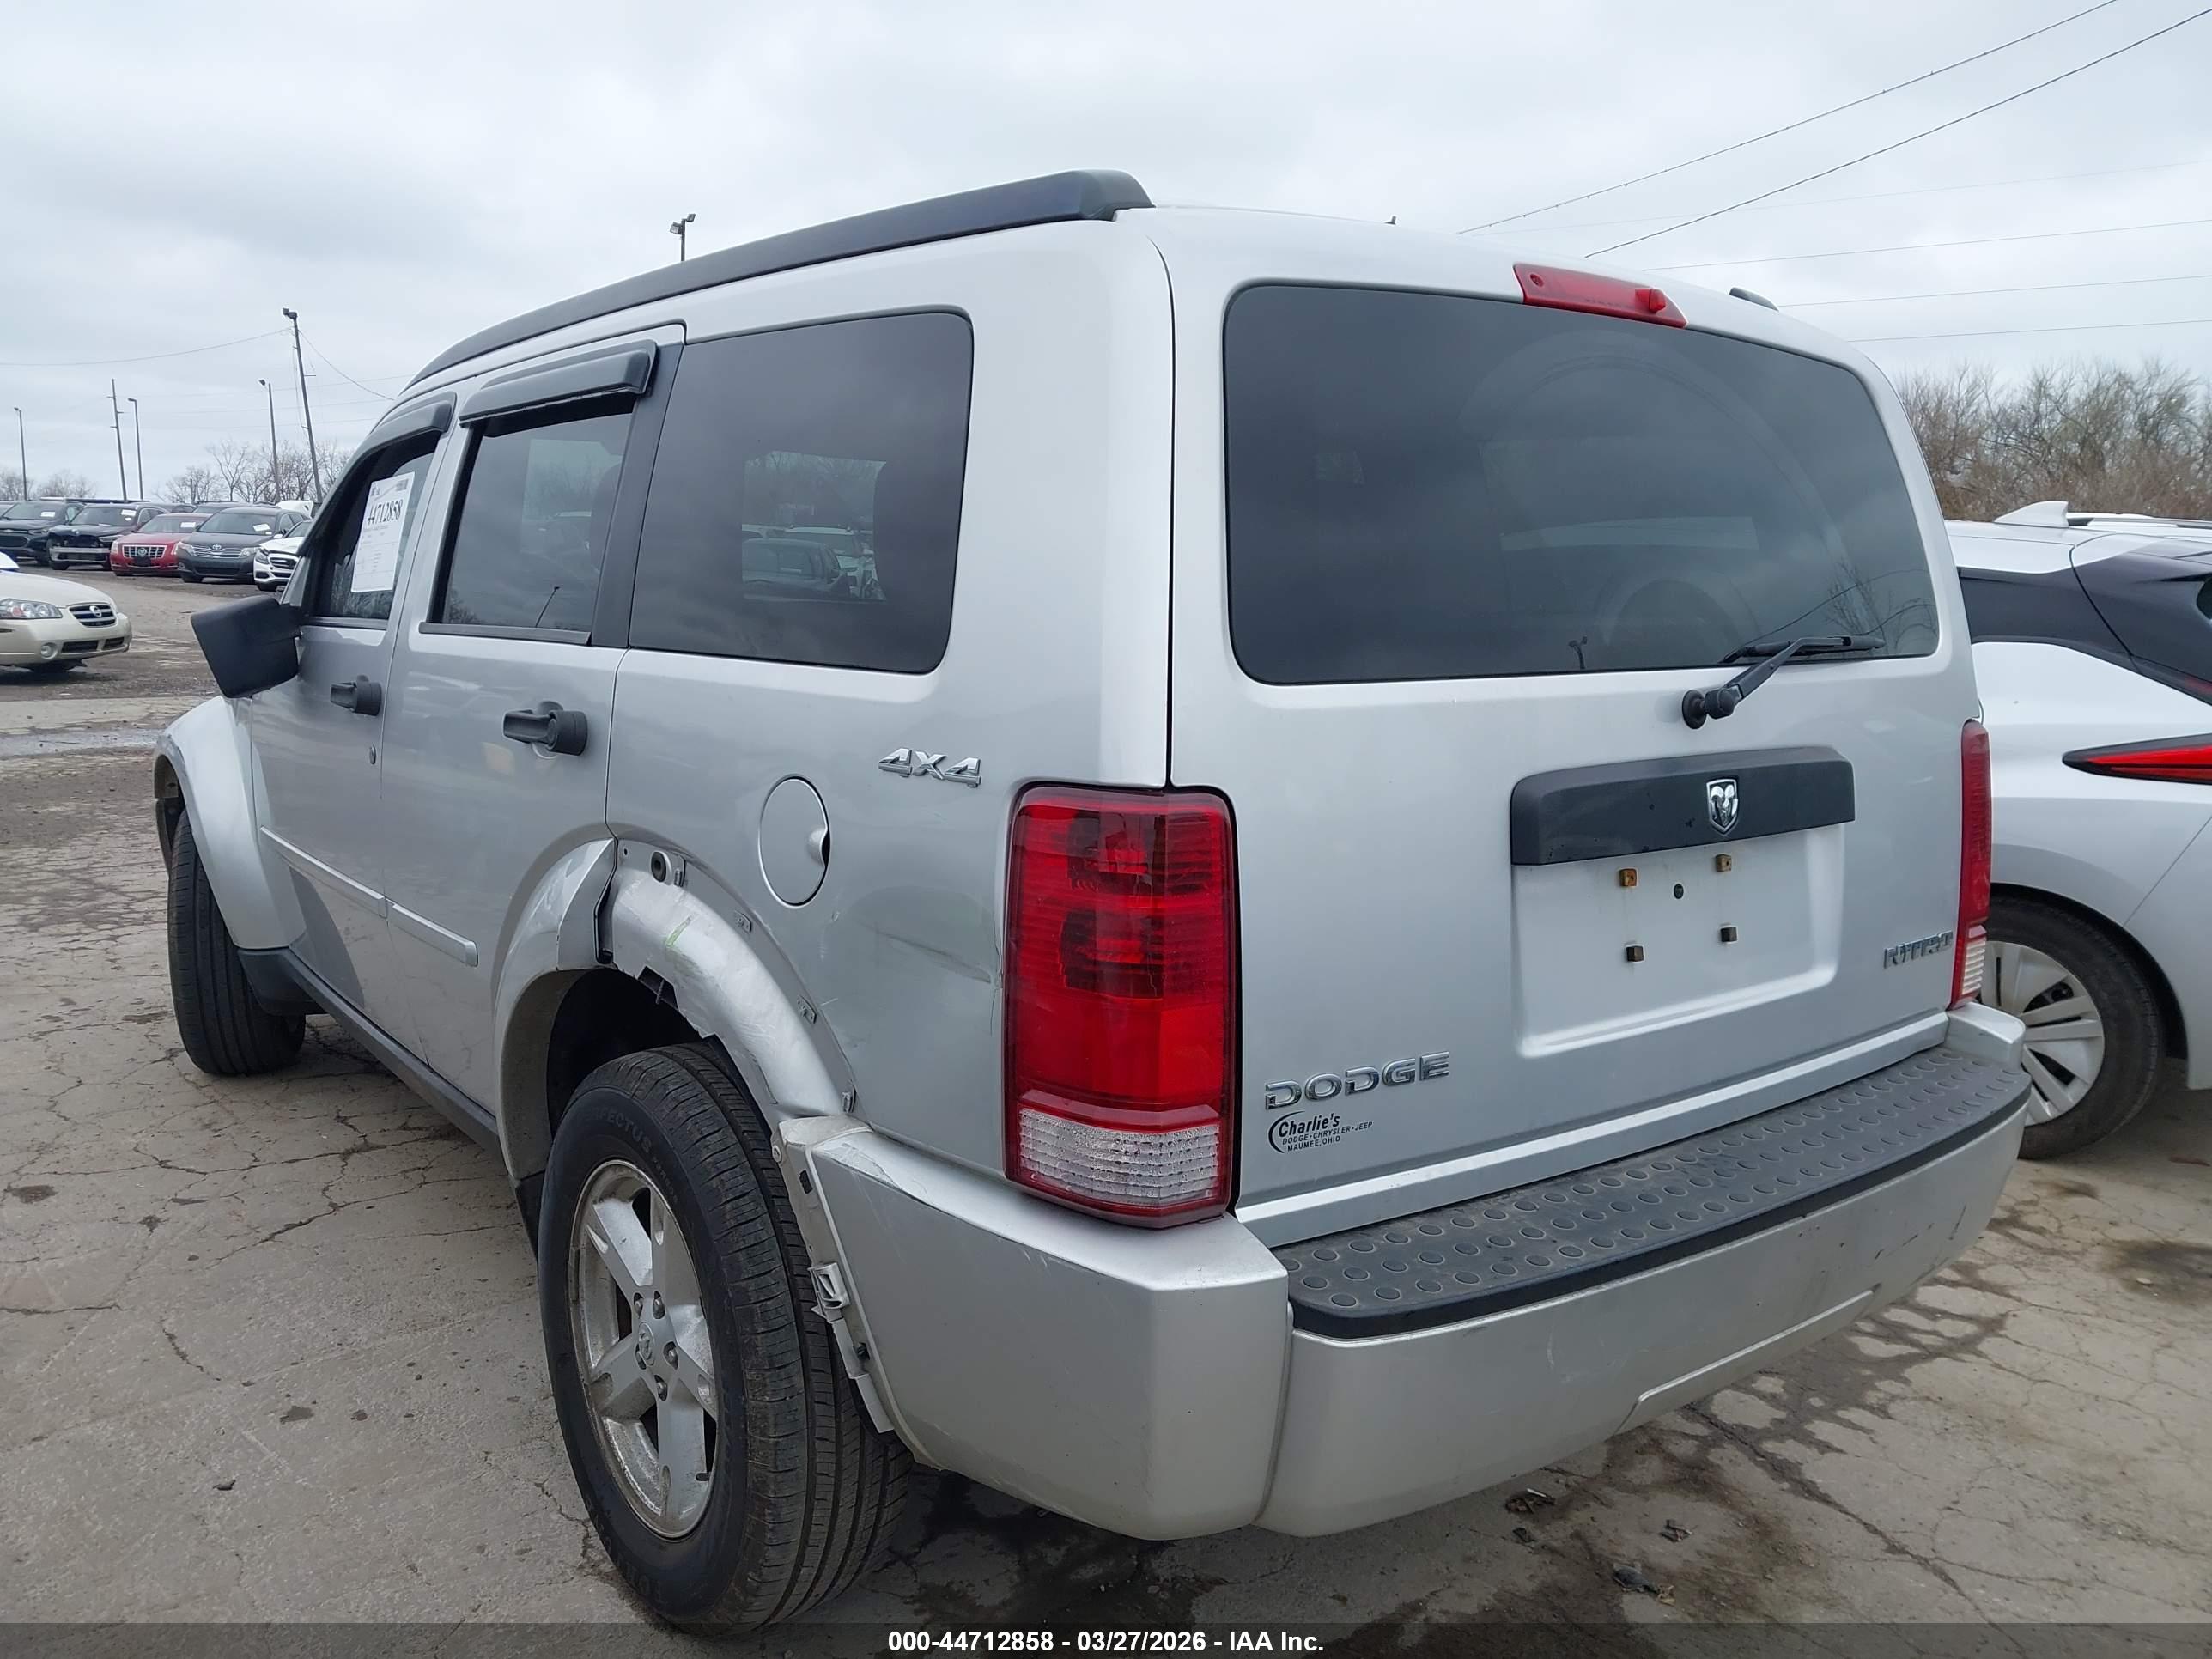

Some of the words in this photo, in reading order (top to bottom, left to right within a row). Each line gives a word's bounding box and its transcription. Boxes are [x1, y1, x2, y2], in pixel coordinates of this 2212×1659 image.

[368, 499, 404, 526] 44712858
[1265, 1051, 1450, 1110] DODGE
[1279, 1113, 1340, 1138] Charlie's
